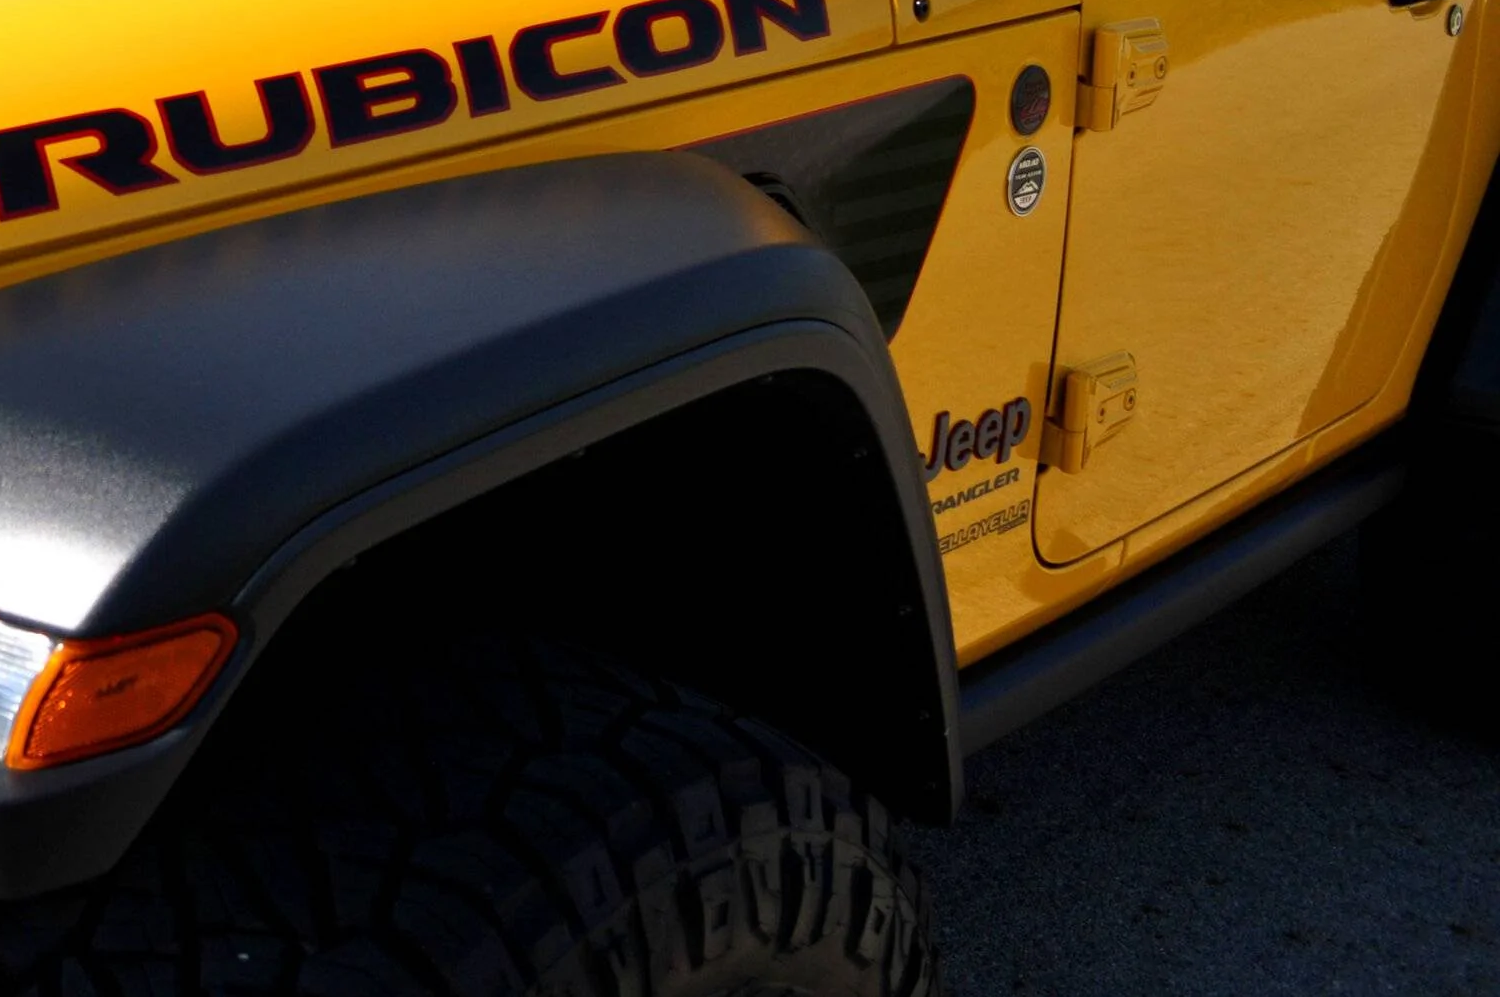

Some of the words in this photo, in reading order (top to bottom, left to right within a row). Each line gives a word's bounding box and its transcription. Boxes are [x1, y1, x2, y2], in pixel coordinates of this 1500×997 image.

[920, 395, 1032, 483] Jeep
[931, 467, 1021, 515] RANGLER
[937, 499, 1032, 555] ELLAYELLA
